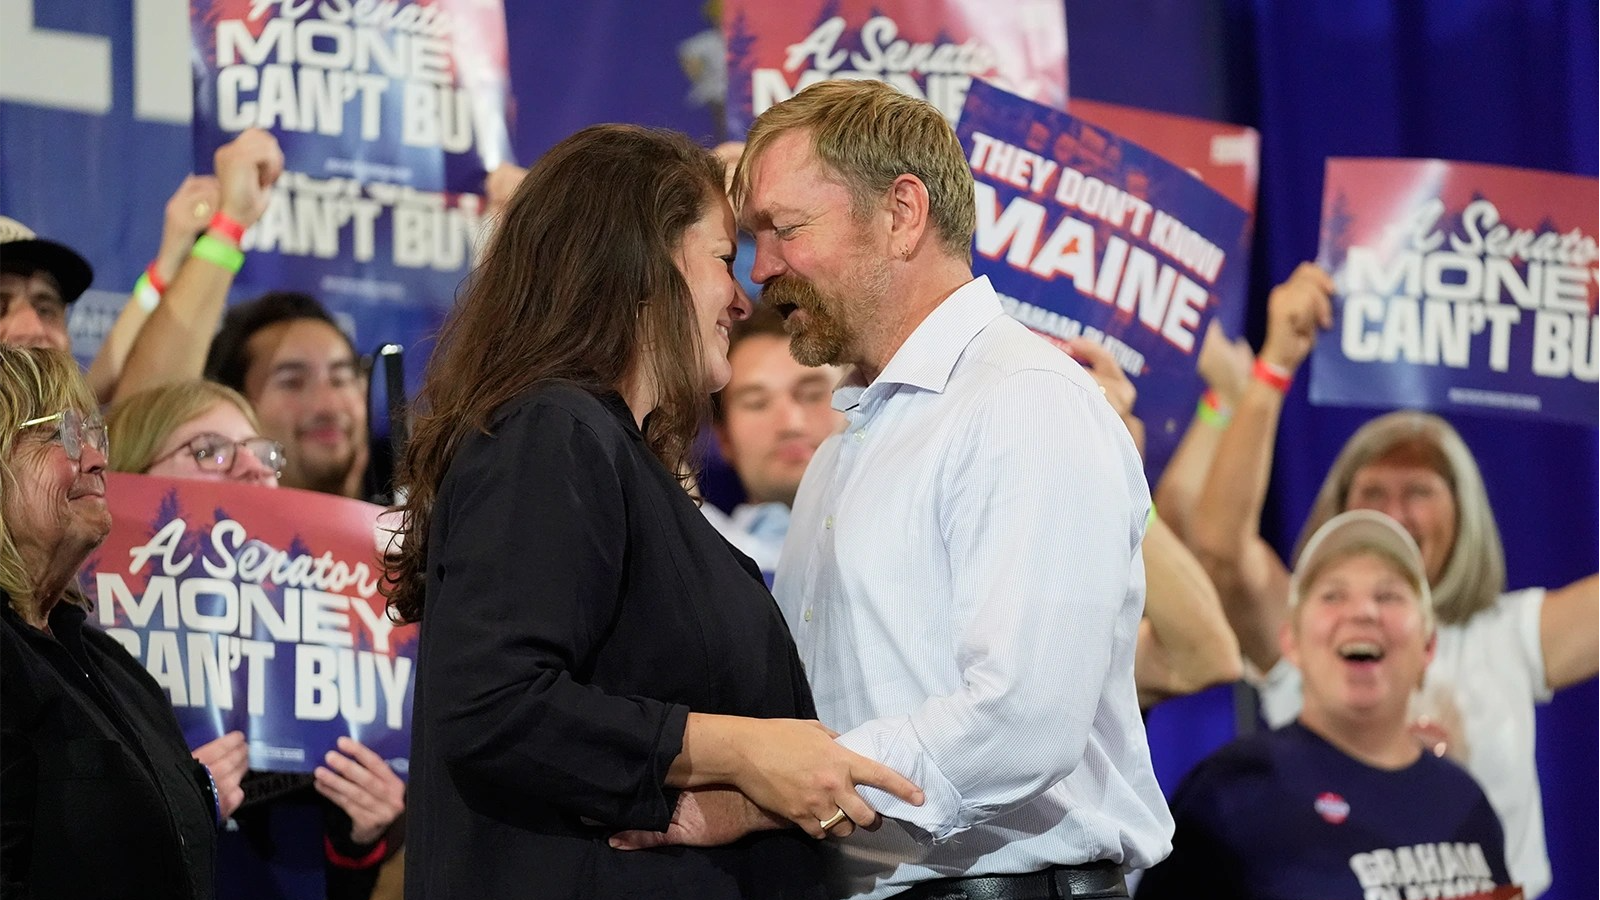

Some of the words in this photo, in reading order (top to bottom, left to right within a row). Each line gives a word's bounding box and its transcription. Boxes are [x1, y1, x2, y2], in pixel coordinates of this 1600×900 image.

[215, 18, 453, 84] MONE
[784, 15, 848, 72] A
[851, 15, 996, 74] Senato
[216, 62, 389, 142] CAN'T
[403, 80, 474, 154] BU
[240, 186, 381, 264] AN'T
[968, 130, 1058, 194] THEY
[1055, 166, 1153, 236] DON'T
[1149, 209, 1225, 284] KNOW
[1450, 199, 1598, 266] Senato
[974, 178, 1210, 353] MAINE
[1344, 245, 1598, 316] MONE
[995, 291, 1082, 342] RAHAM
[1340, 296, 1521, 373] CAN'T
[1531, 310, 1599, 383] BU
[129, 517, 194, 577] A
[202, 518, 379, 598] Senator
[95, 572, 396, 654] MONEY
[295, 643, 412, 730] BUY
[1349, 841, 1493, 889] GRAHAM
